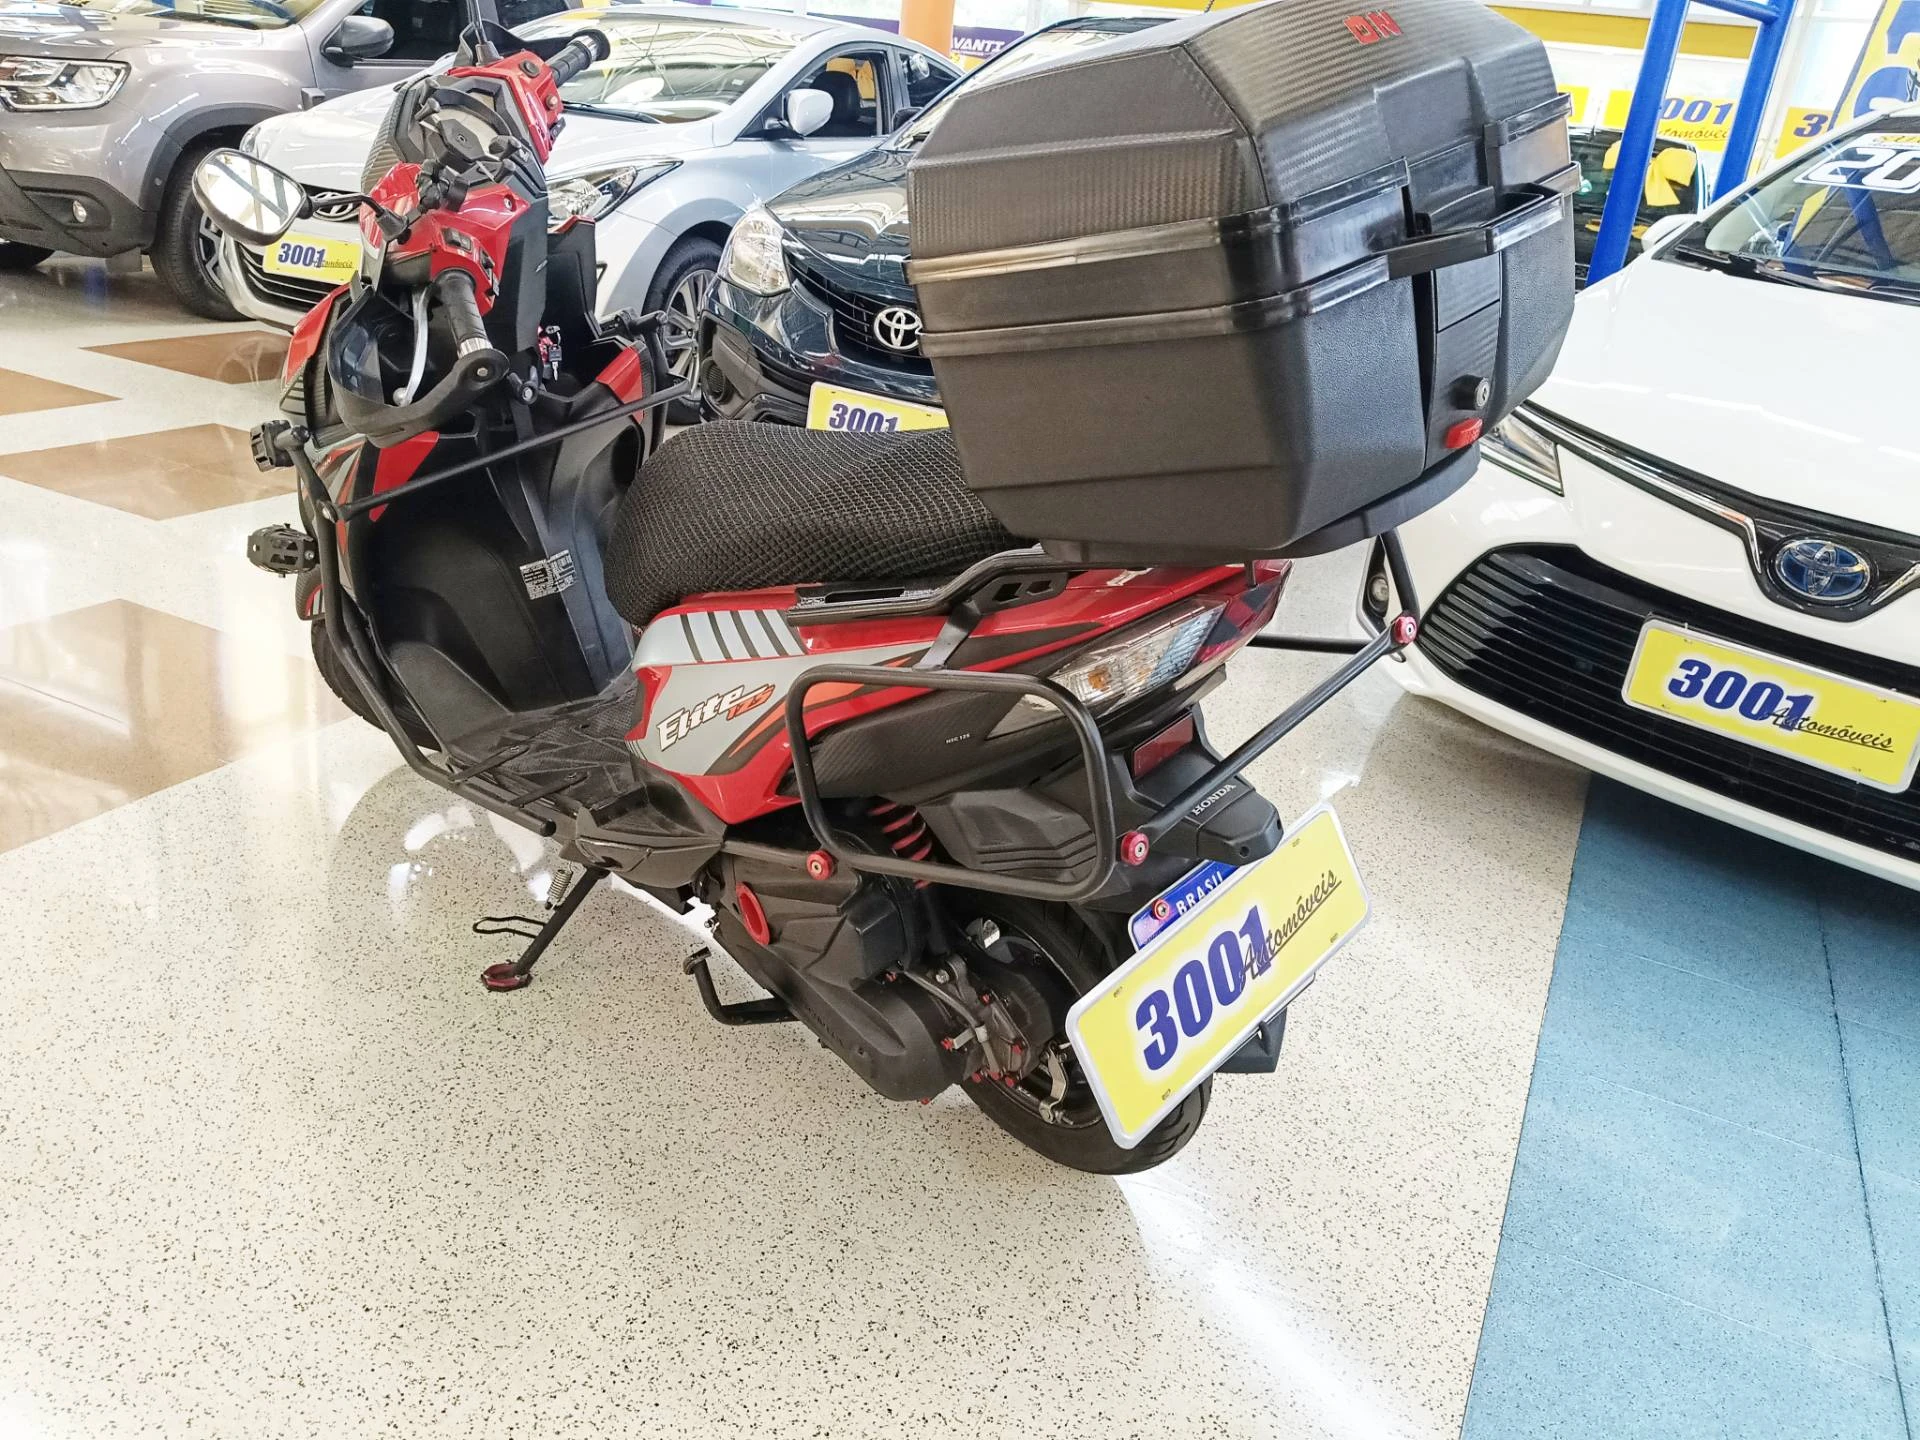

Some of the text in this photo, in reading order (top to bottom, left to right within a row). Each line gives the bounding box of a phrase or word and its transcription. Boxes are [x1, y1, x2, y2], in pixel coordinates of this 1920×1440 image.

[953, 37, 1005, 52] VANTI
[1660, 97, 1733, 125] 001
[1793, 113, 1829, 138] 3
[1807, 147, 1920, 188] 20
[278, 243, 325, 268] 3001
[828, 403, 899, 432] 3001
[1668, 658, 1814, 732] 3001
[656, 684, 769, 752] Elite
[1760, 707, 1895, 753] Automóveis
[1191, 783, 1237, 816] HONDA
[1176, 871, 1223, 915] BRASIL
[1239, 869, 1342, 990] Automóveis
[1135, 905, 1272, 1071] 3001
